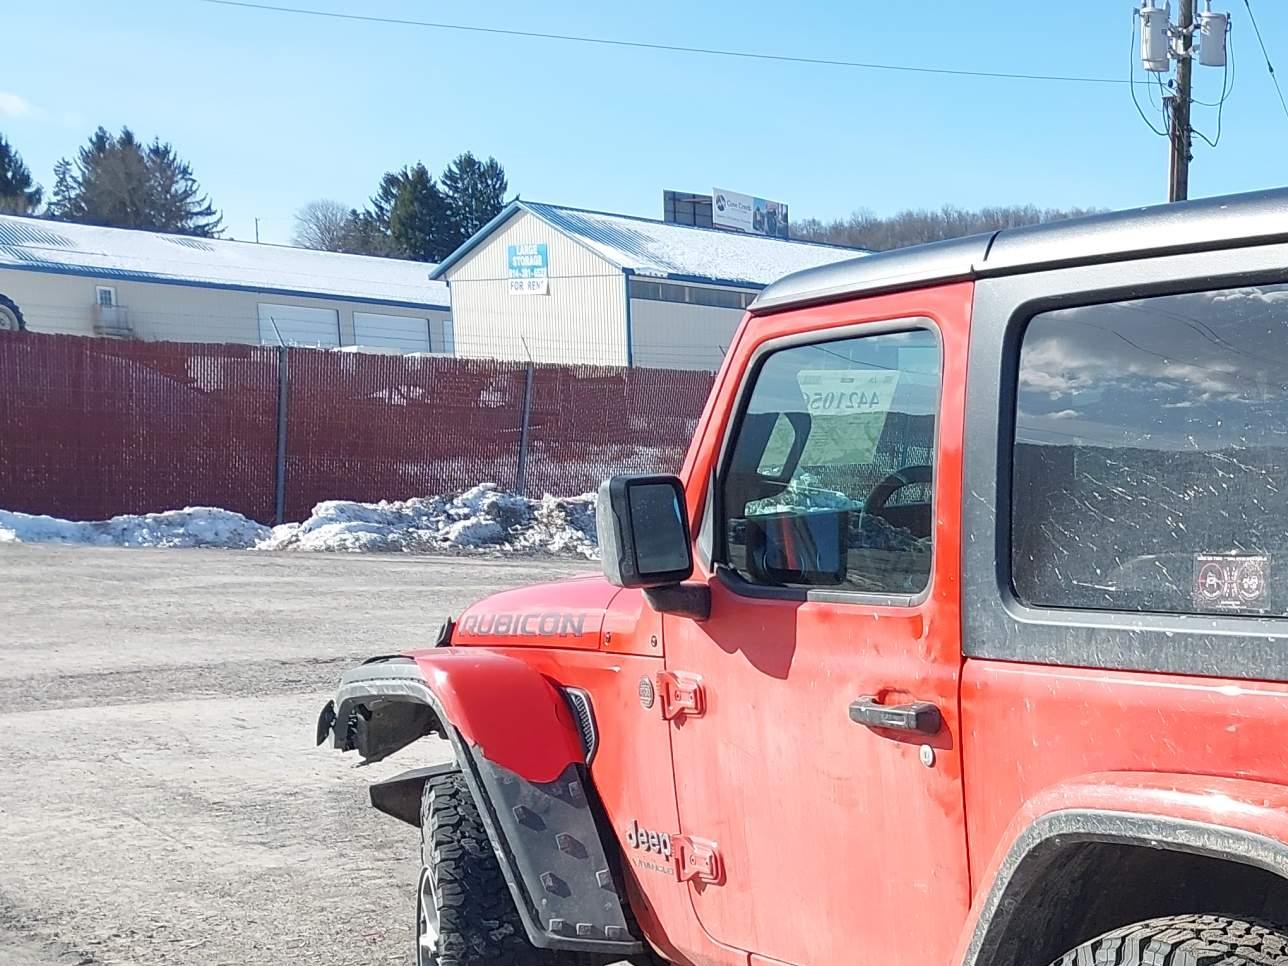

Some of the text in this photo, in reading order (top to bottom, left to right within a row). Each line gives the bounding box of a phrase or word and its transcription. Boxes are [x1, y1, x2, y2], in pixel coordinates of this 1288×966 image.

[512, 255, 543, 267] STORAGE
[510, 280, 544, 291] FOR RENT
[459, 613, 586, 638] RUBICON
[626, 819, 672, 860] Jeep
